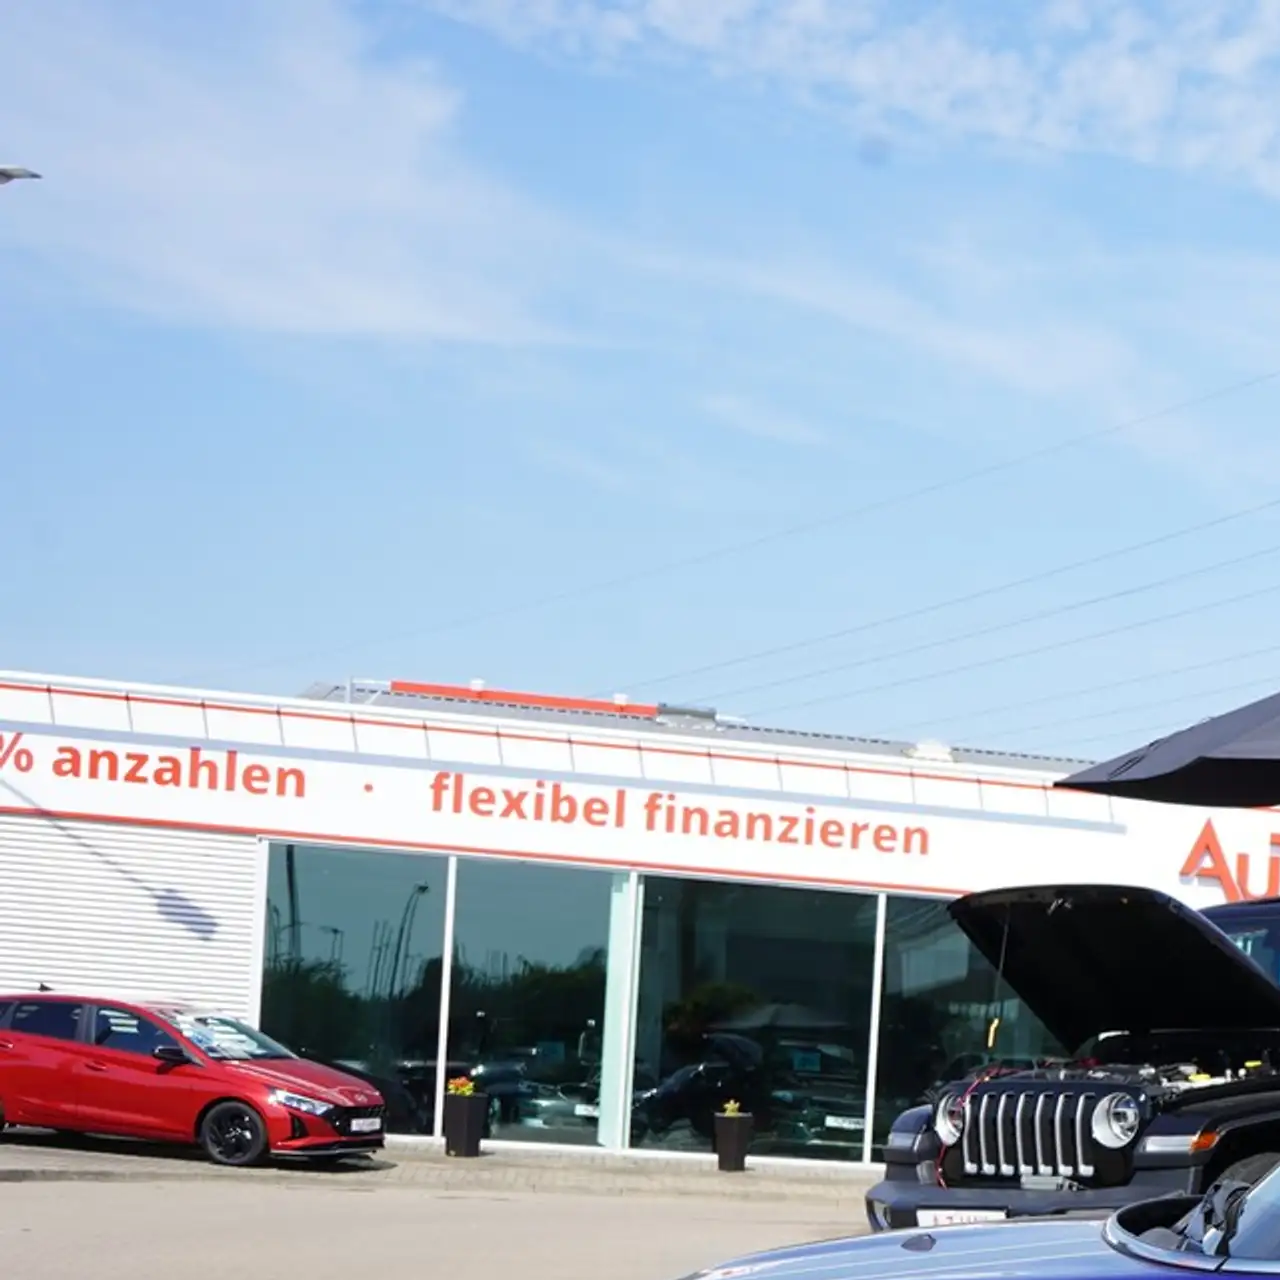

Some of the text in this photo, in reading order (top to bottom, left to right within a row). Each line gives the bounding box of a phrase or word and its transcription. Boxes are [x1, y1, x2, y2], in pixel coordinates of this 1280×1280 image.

[52, 746, 306, 798] anzahlen
[429, 771, 627, 828] flexibel
[644, 793, 931, 856] finanzieren
